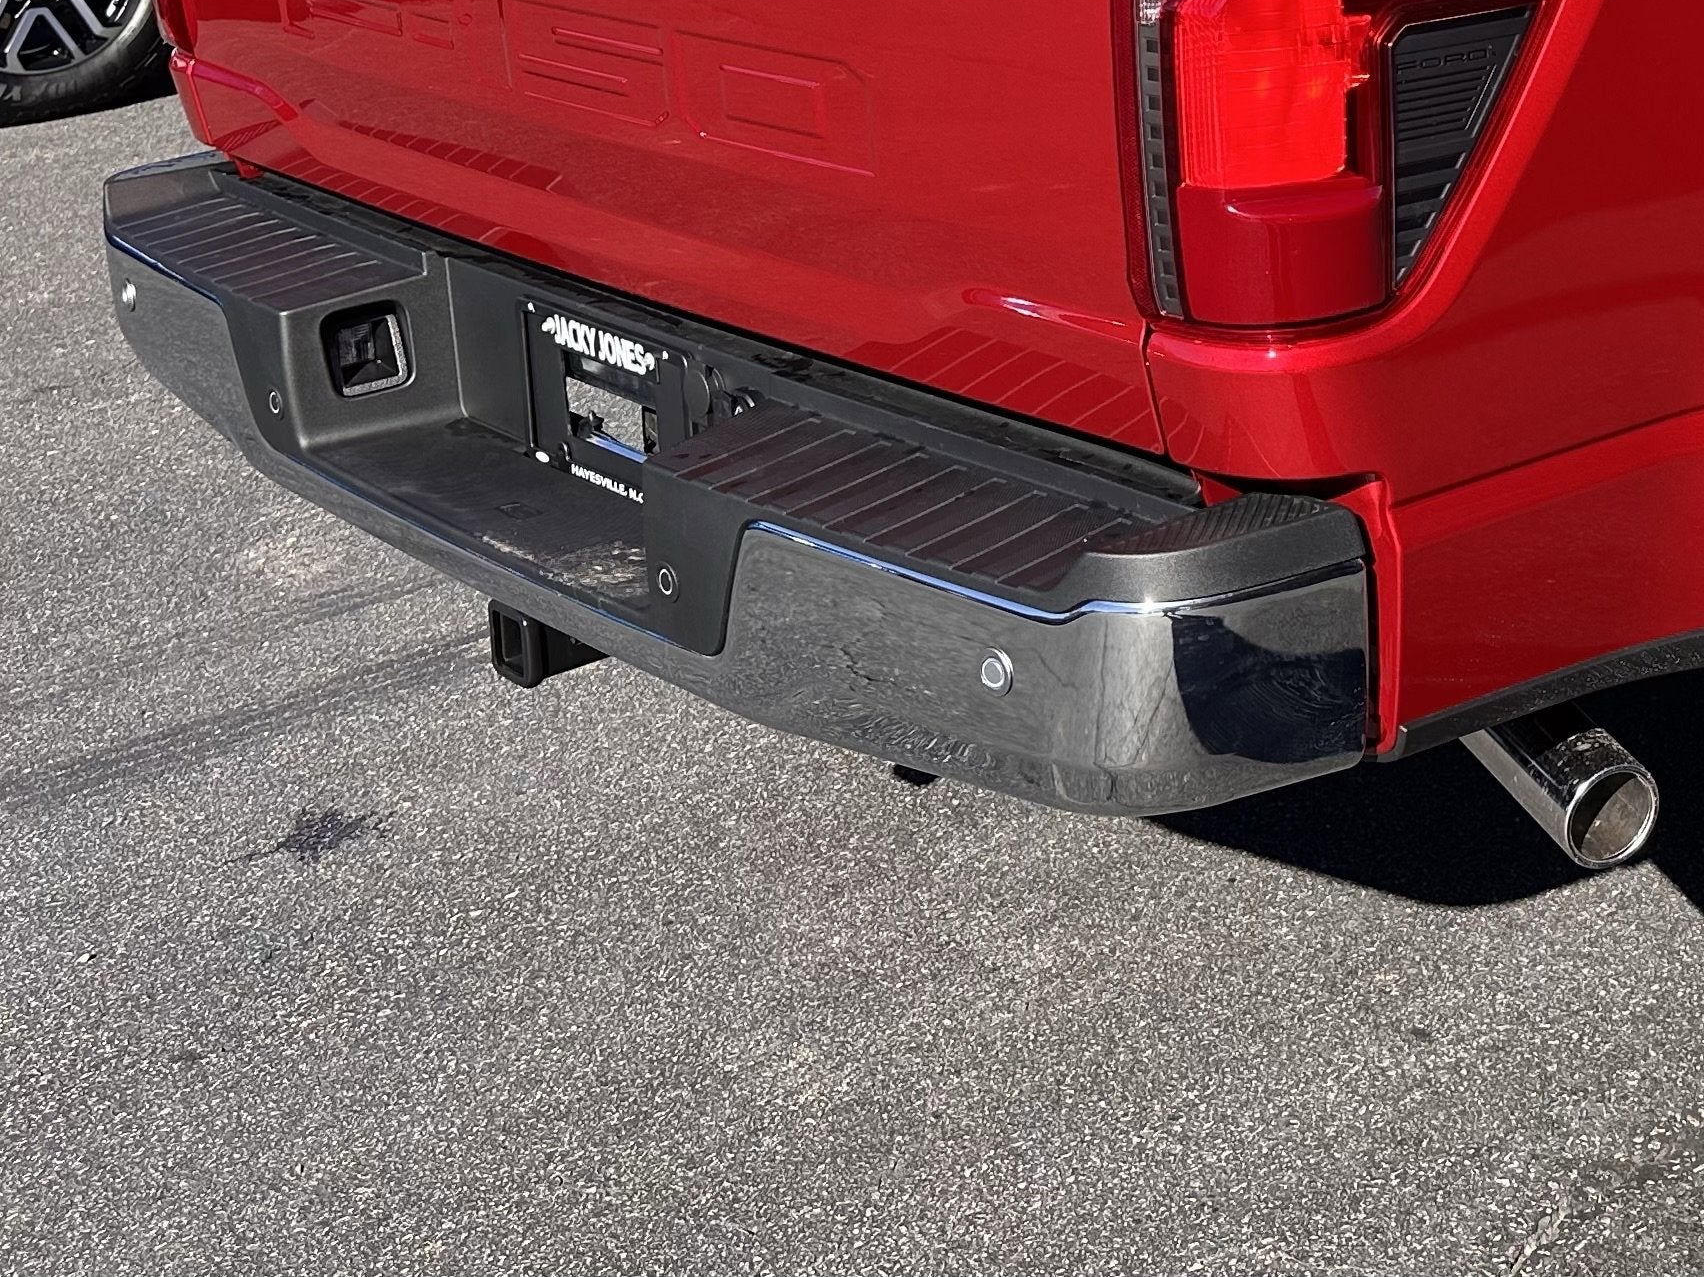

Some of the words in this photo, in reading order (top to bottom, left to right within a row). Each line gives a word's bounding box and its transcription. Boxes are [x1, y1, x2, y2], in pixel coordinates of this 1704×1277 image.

[1396, 48, 1490, 75] FORD
[553, 313, 597, 357] JACKY
[598, 329, 647, 375] JONES
